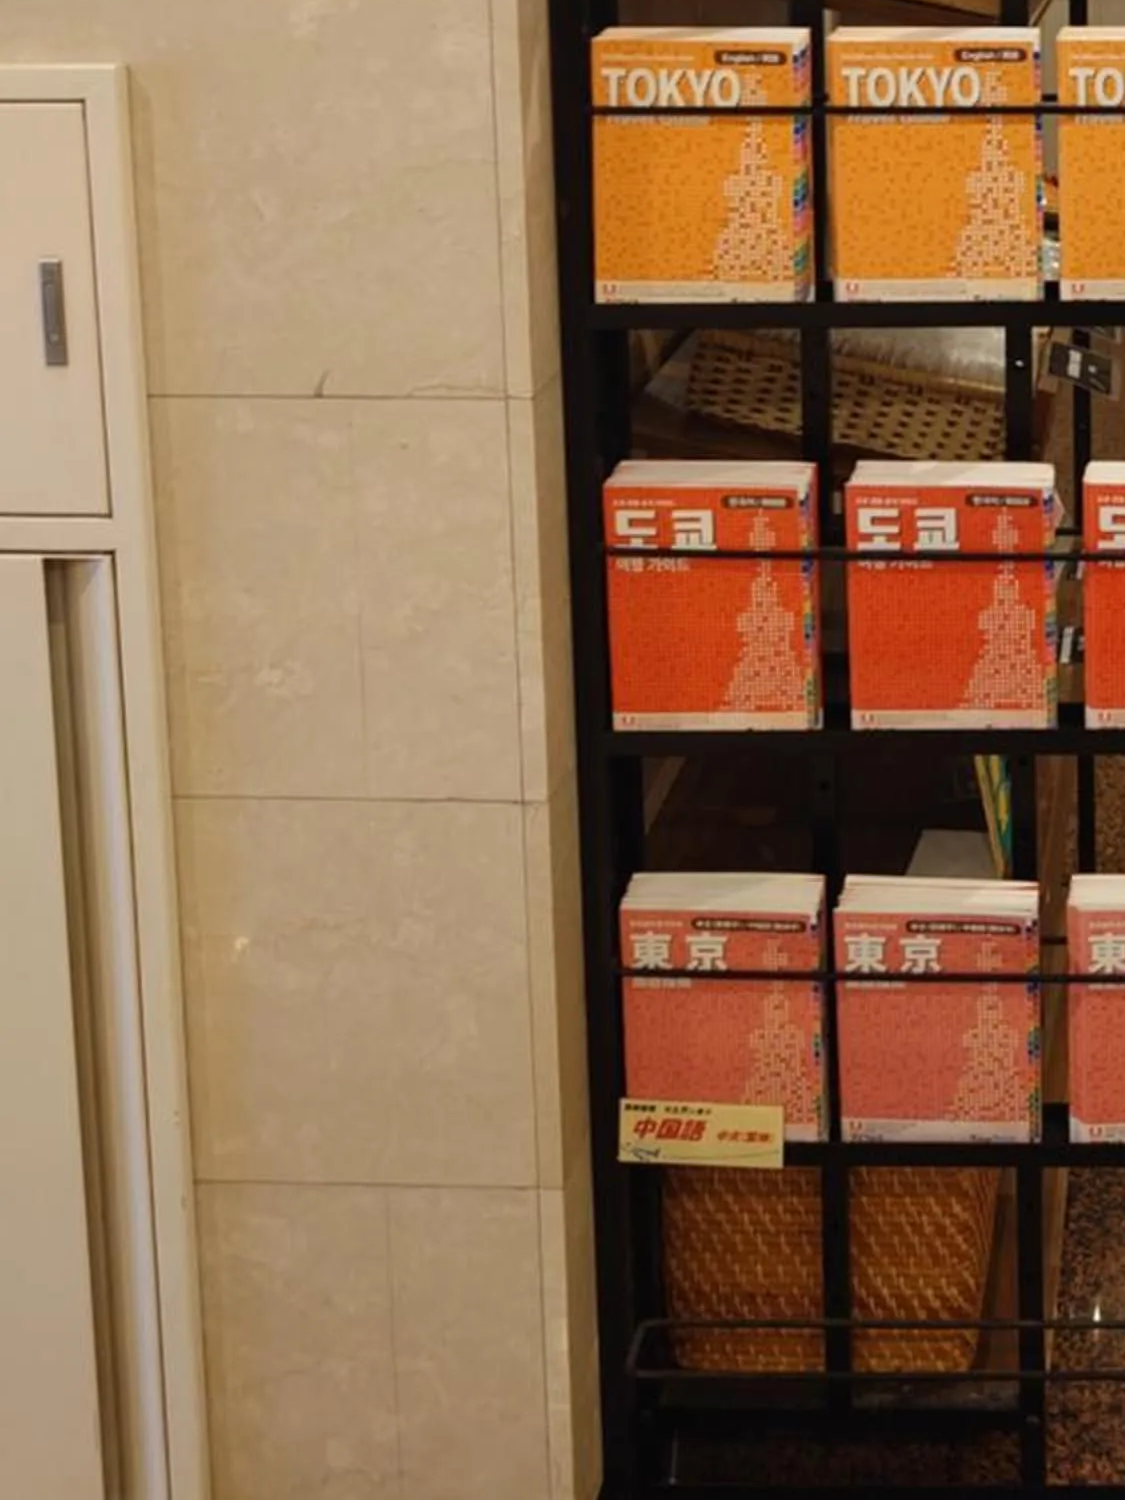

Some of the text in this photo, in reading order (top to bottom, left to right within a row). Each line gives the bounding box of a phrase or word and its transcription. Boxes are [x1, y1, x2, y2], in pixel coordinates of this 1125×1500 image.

[601, 67, 741, 108] TOKYO
[841, 66, 980, 108] TOKYO
[614, 509, 717, 550] 도쿄
[857, 508, 960, 550] 도쿄
[630, 930, 728, 972] 東京
[844, 933, 942, 974] 東京
[634, 1117, 707, 1142] 中国語
